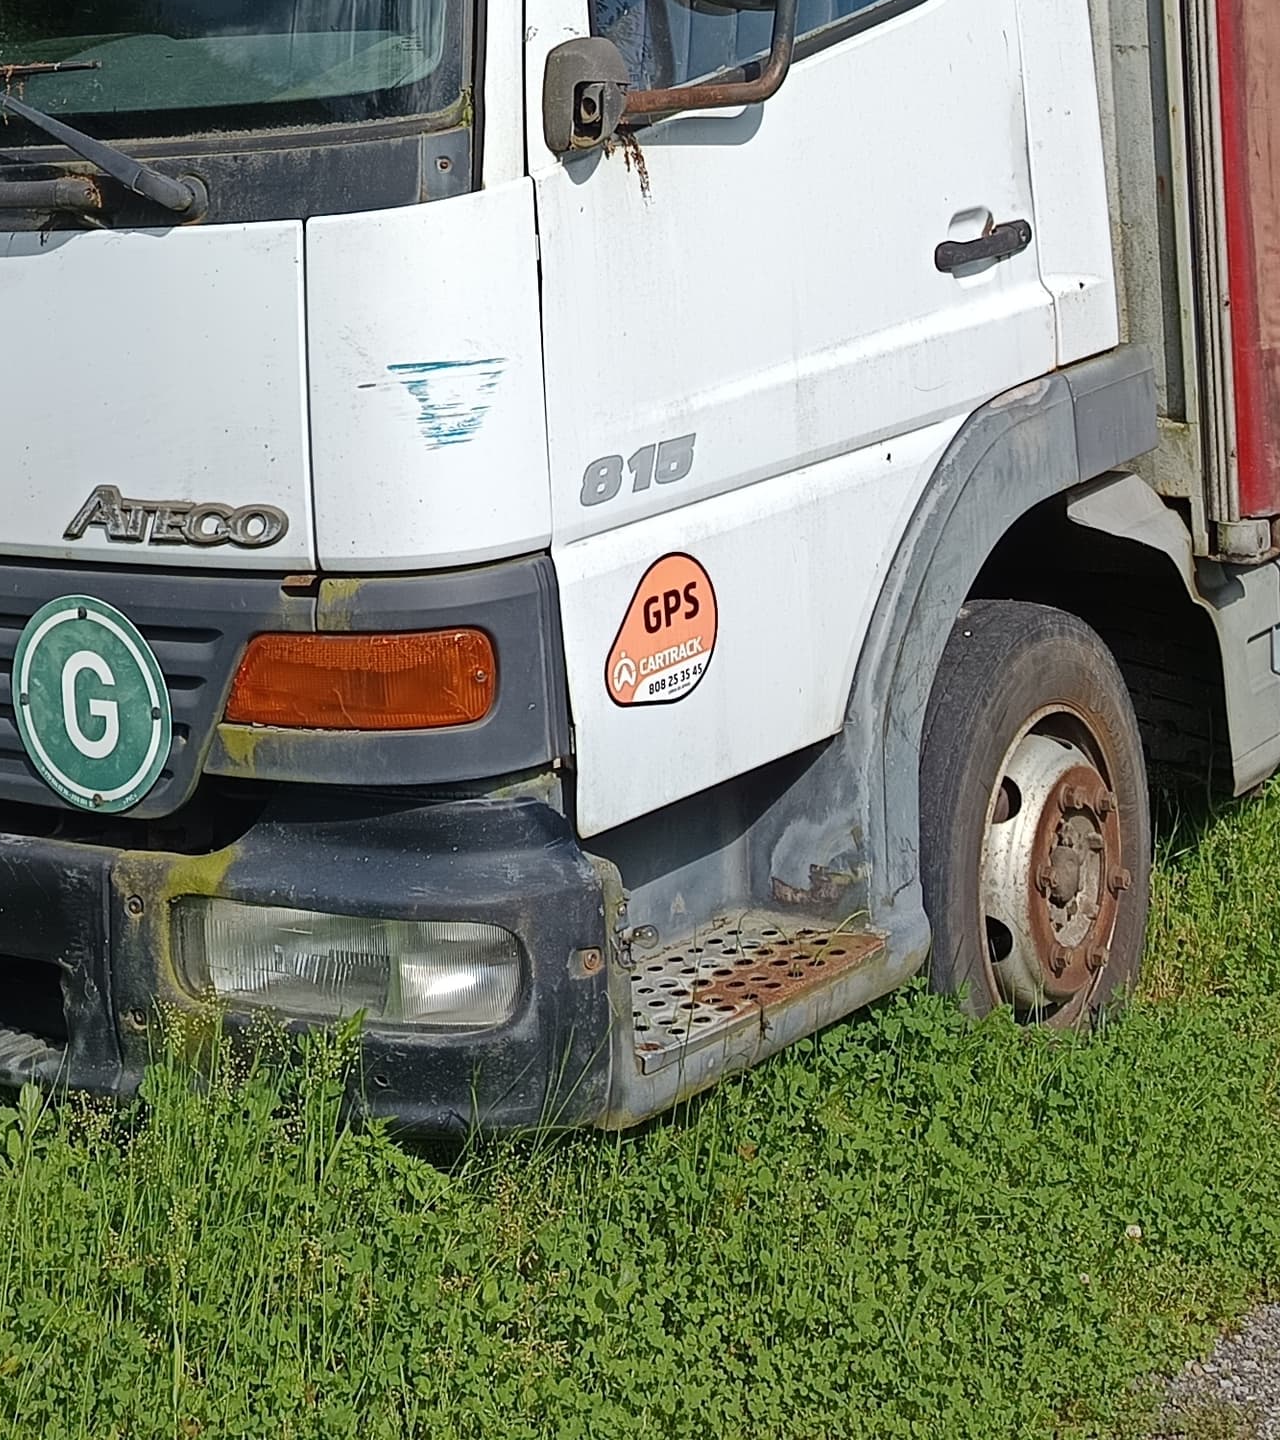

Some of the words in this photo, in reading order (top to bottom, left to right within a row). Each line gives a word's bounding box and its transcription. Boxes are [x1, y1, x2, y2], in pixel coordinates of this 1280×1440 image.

[579, 432, 697, 508] 815
[642, 580, 700, 635] GPS
[638, 635, 704, 676] CARTRACK
[668, 672, 680, 688] 25
[680, 667, 691, 682] 35
[692, 662, 703, 676] 45
[59, 649, 120, 760] G
